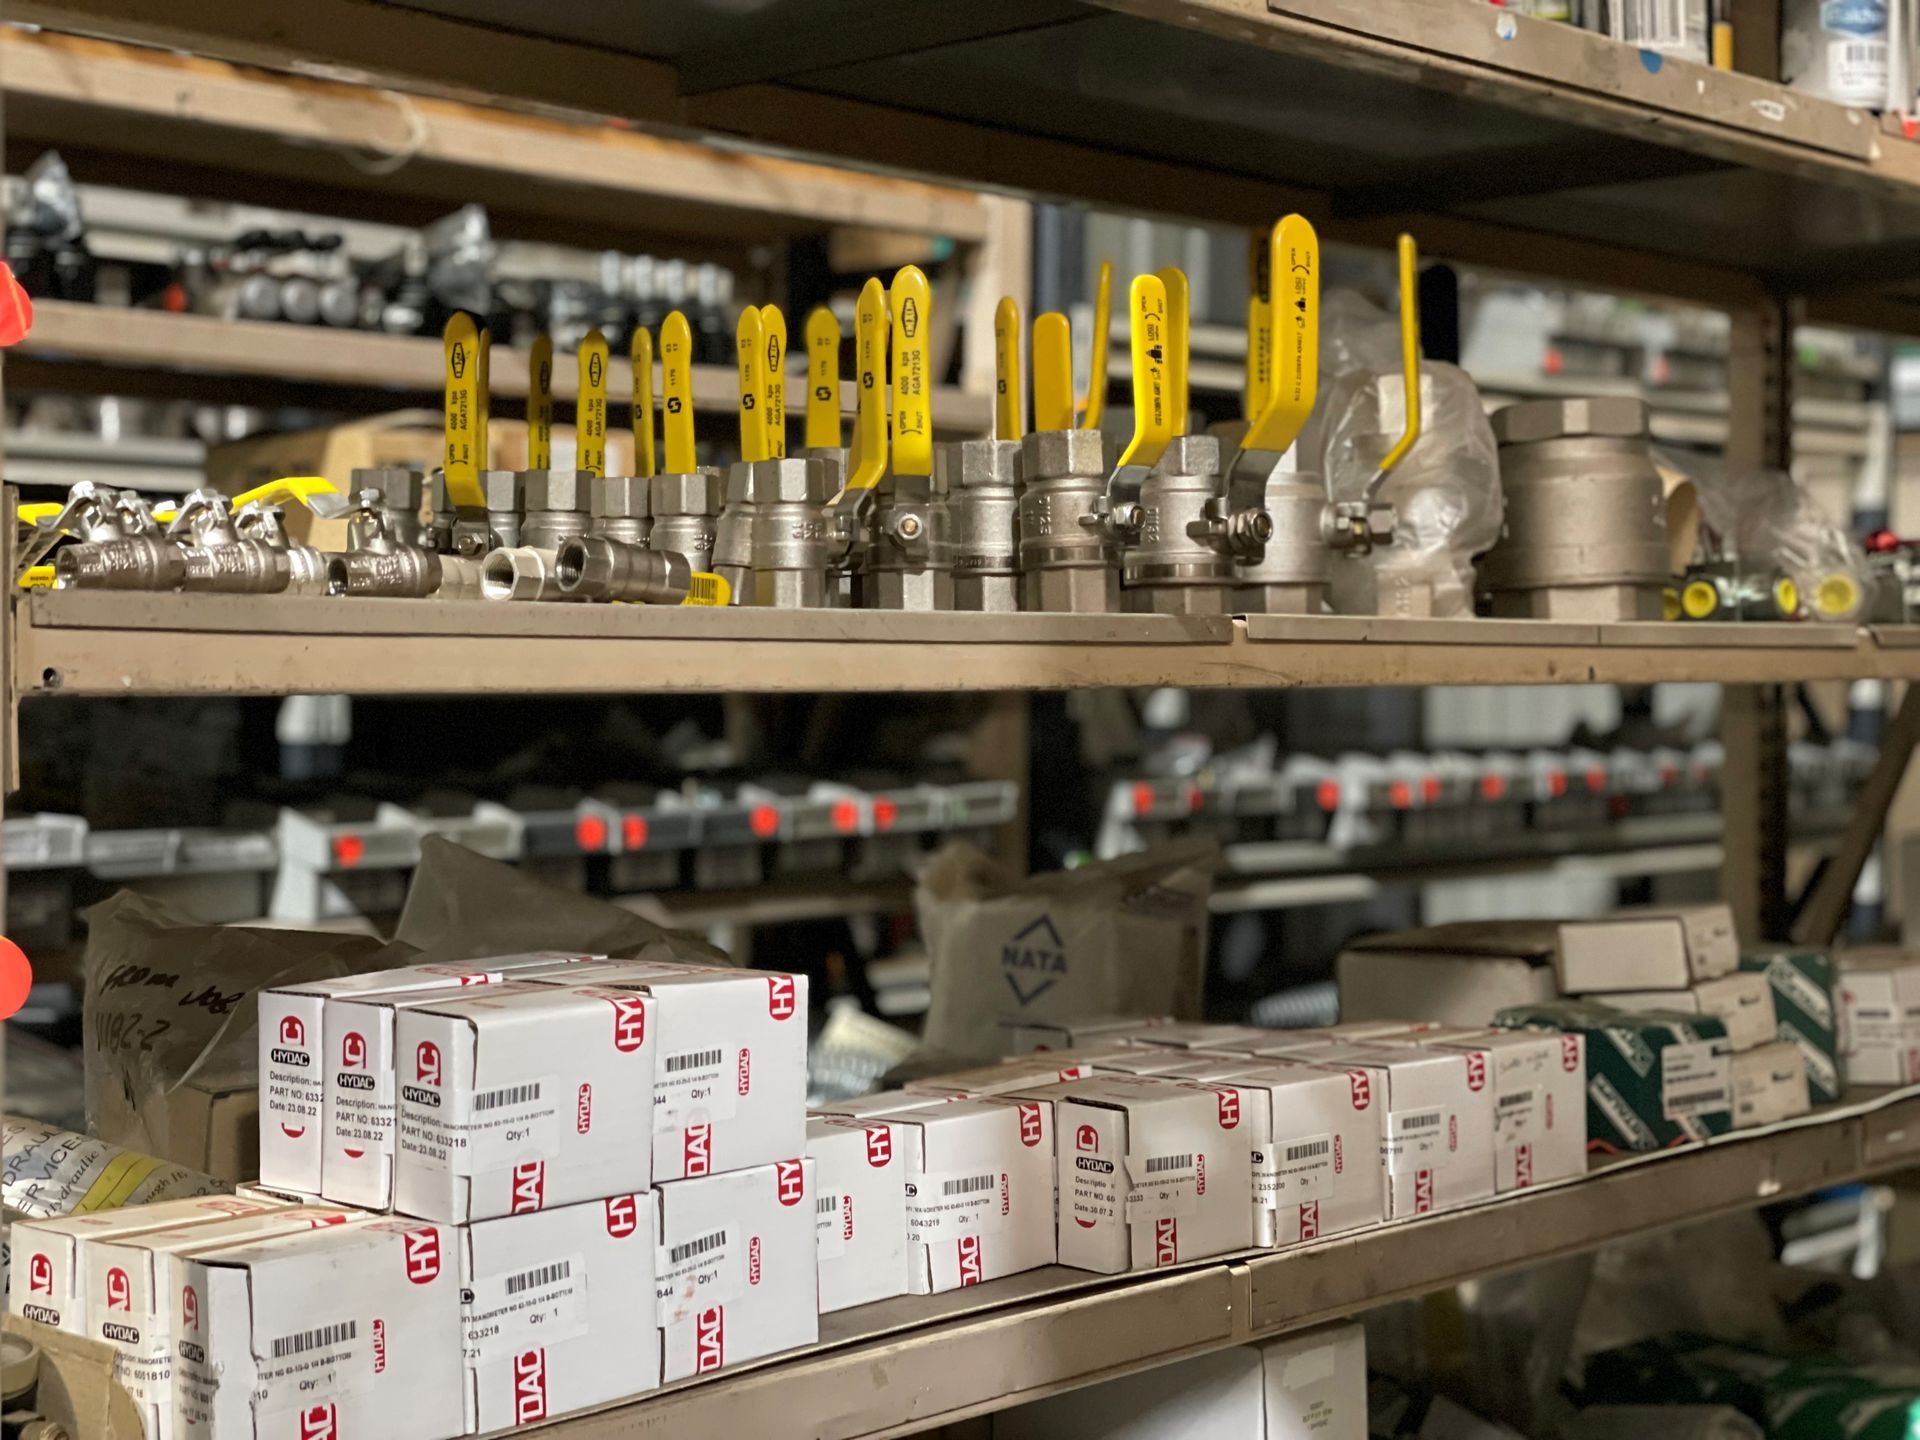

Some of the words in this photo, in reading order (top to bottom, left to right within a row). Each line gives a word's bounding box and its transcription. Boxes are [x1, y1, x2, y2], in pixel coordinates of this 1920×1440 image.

[1002, 944, 1068, 975] NATA
[770, 975, 795, 1019] HY
[271, 1048, 310, 1067] HYDAC
[738, 1048, 750, 1096] HYDAC
[1467, 1052, 1485, 1091] HY
[270, 1085, 288, 1098] PART
[337, 1072, 375, 1091] HYDAC
[402, 1085, 441, 1108] HYDAC
[1352, 1070, 1370, 1110] HY
[336, 1111, 355, 1123] PART
[577, 1083, 592, 1134] HYDAC
[1019, 1102, 1042, 1147] HY
[1219, 1089, 1240, 1129] HY
[401, 1124, 420, 1137] PART
[436, 1134, 467, 1148] 633218
[867, 1124, 891, 1167] HY
[778, 1159, 803, 1206] HY
[1076, 1156, 1114, 1174] HYDAC
[1075, 1189, 1092, 1198] PART
[843, 1195, 853, 1240] HYDAC
[406, 1228, 440, 1283] HY
[749, 1237, 760, 1285] HYDAC
[23, 1303, 60, 1326] HYDAC
[103, 1322, 140, 1345] HYDAC
[373, 1319, 385, 1374] HYDAC
[468, 1325, 499, 1340] 633218
[179, 1340, 205, 1364] HYDAC
